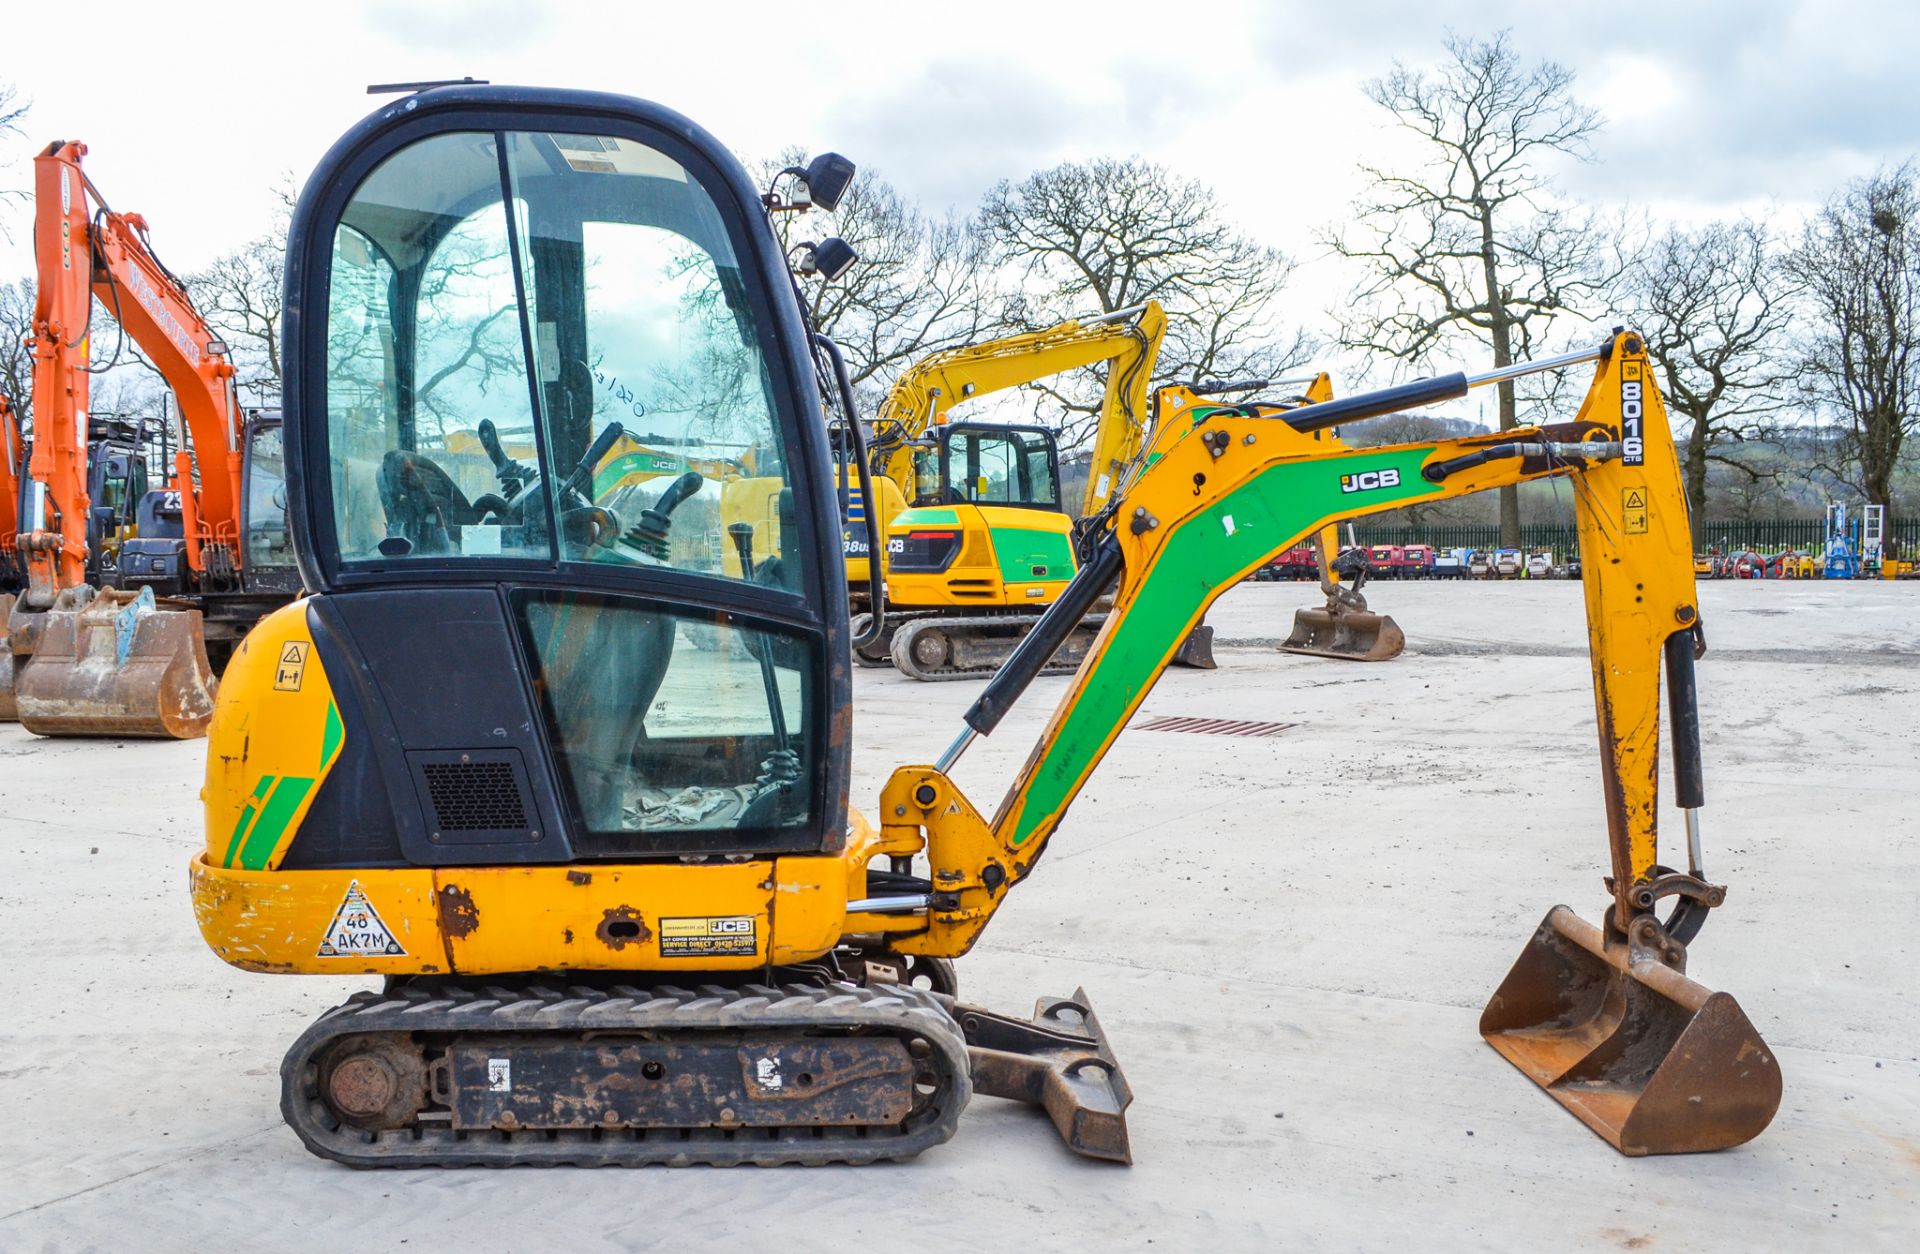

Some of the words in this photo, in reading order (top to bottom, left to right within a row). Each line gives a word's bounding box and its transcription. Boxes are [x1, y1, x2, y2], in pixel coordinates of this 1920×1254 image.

[1622, 382, 1642, 456] 8016
[1341, 469, 1400, 493] JCB
[711, 921, 750, 932] JCB
[338, 933, 384, 948] AK7M
